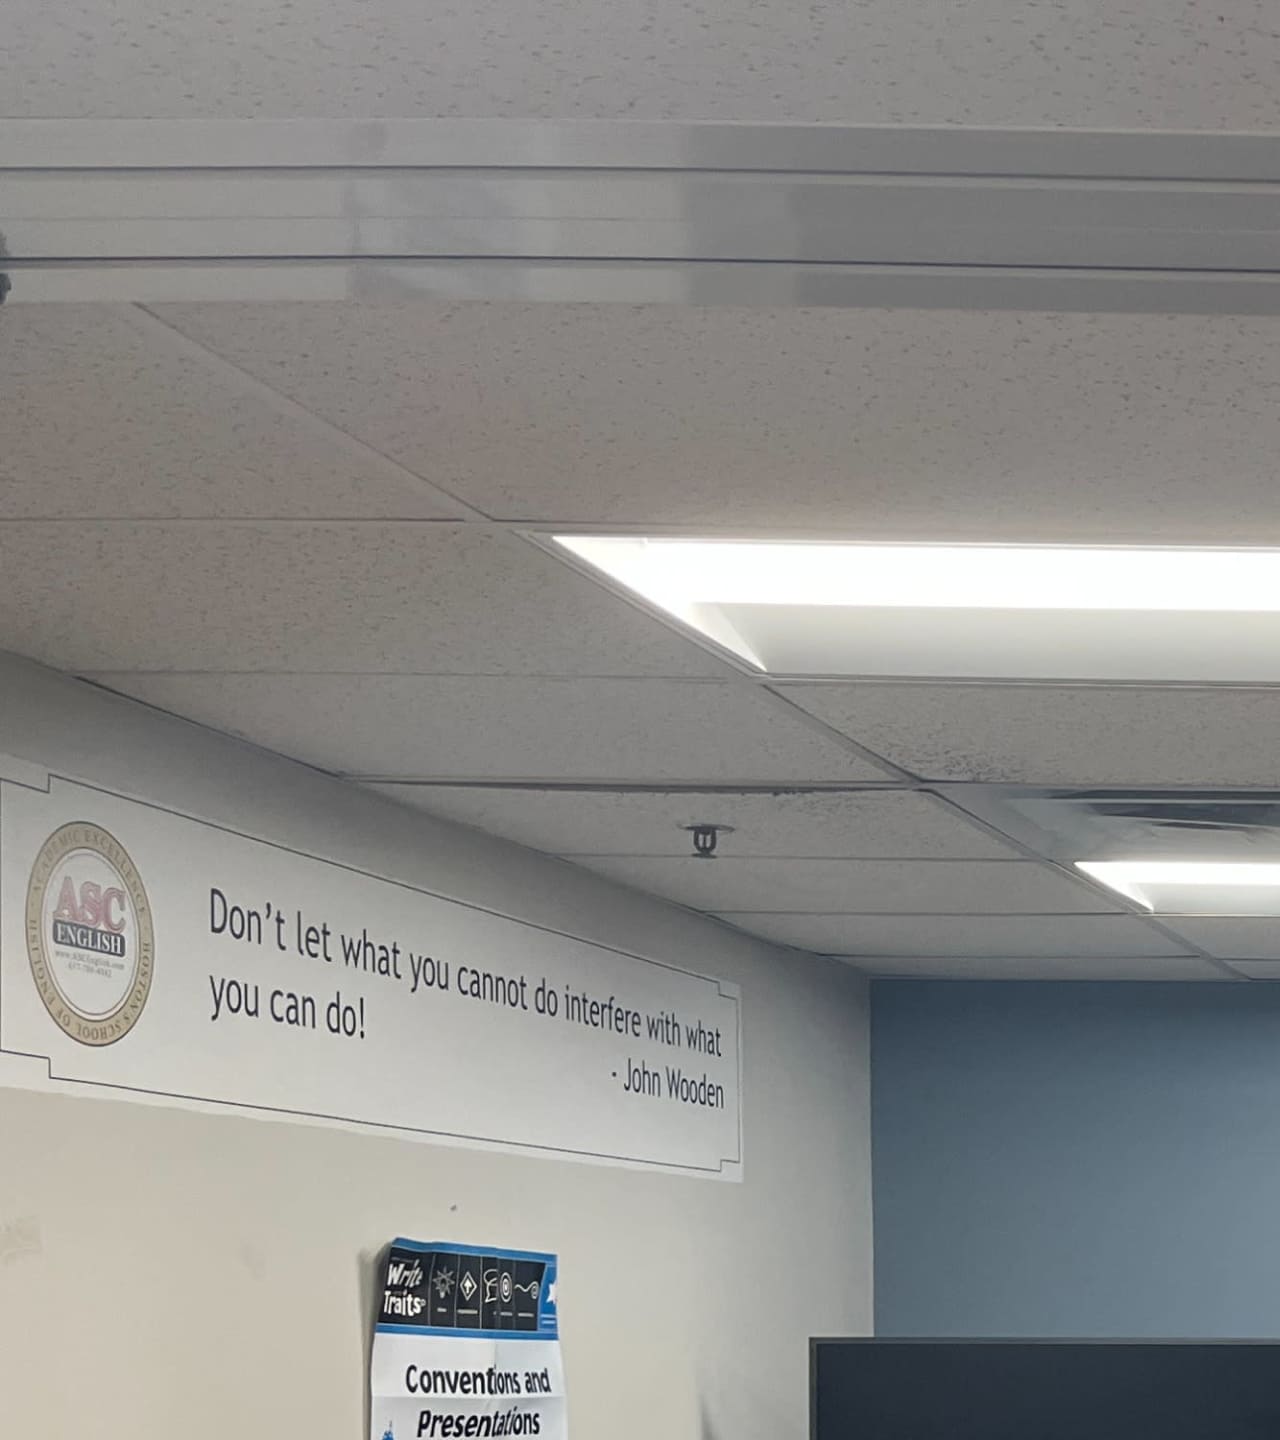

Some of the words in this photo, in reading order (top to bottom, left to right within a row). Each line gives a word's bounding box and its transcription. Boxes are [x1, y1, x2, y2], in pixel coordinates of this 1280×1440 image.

[52, 875, 127, 934] ASC
[55, 923, 122, 955] ENGLISH
[210, 887, 287, 952] Don't
[297, 910, 333, 963] let
[340, 928, 402, 980] what
[409, 953, 449, 994] you
[457, 966, 529, 1011] cannot
[534, 977, 559, 1017] do
[564, 984, 642, 1038] interfere
[646, 1012, 681, 1047] with
[686, 1020, 722, 1058] what
[209, 975, 259, 1022] you
[269, 989, 316, 1030] can
[326, 990, 365, 1040] do!
[75, 1022, 121, 1041] SCHOOL
[623, 1057, 661, 1097] John
[665, 1066, 724, 1109] Wooden
[386, 1258, 425, 1289] Write
[405, 1363, 522, 1394] Conventions
[524, 1367, 552, 1394] and
[416, 1406, 541, 1438] Presentations
